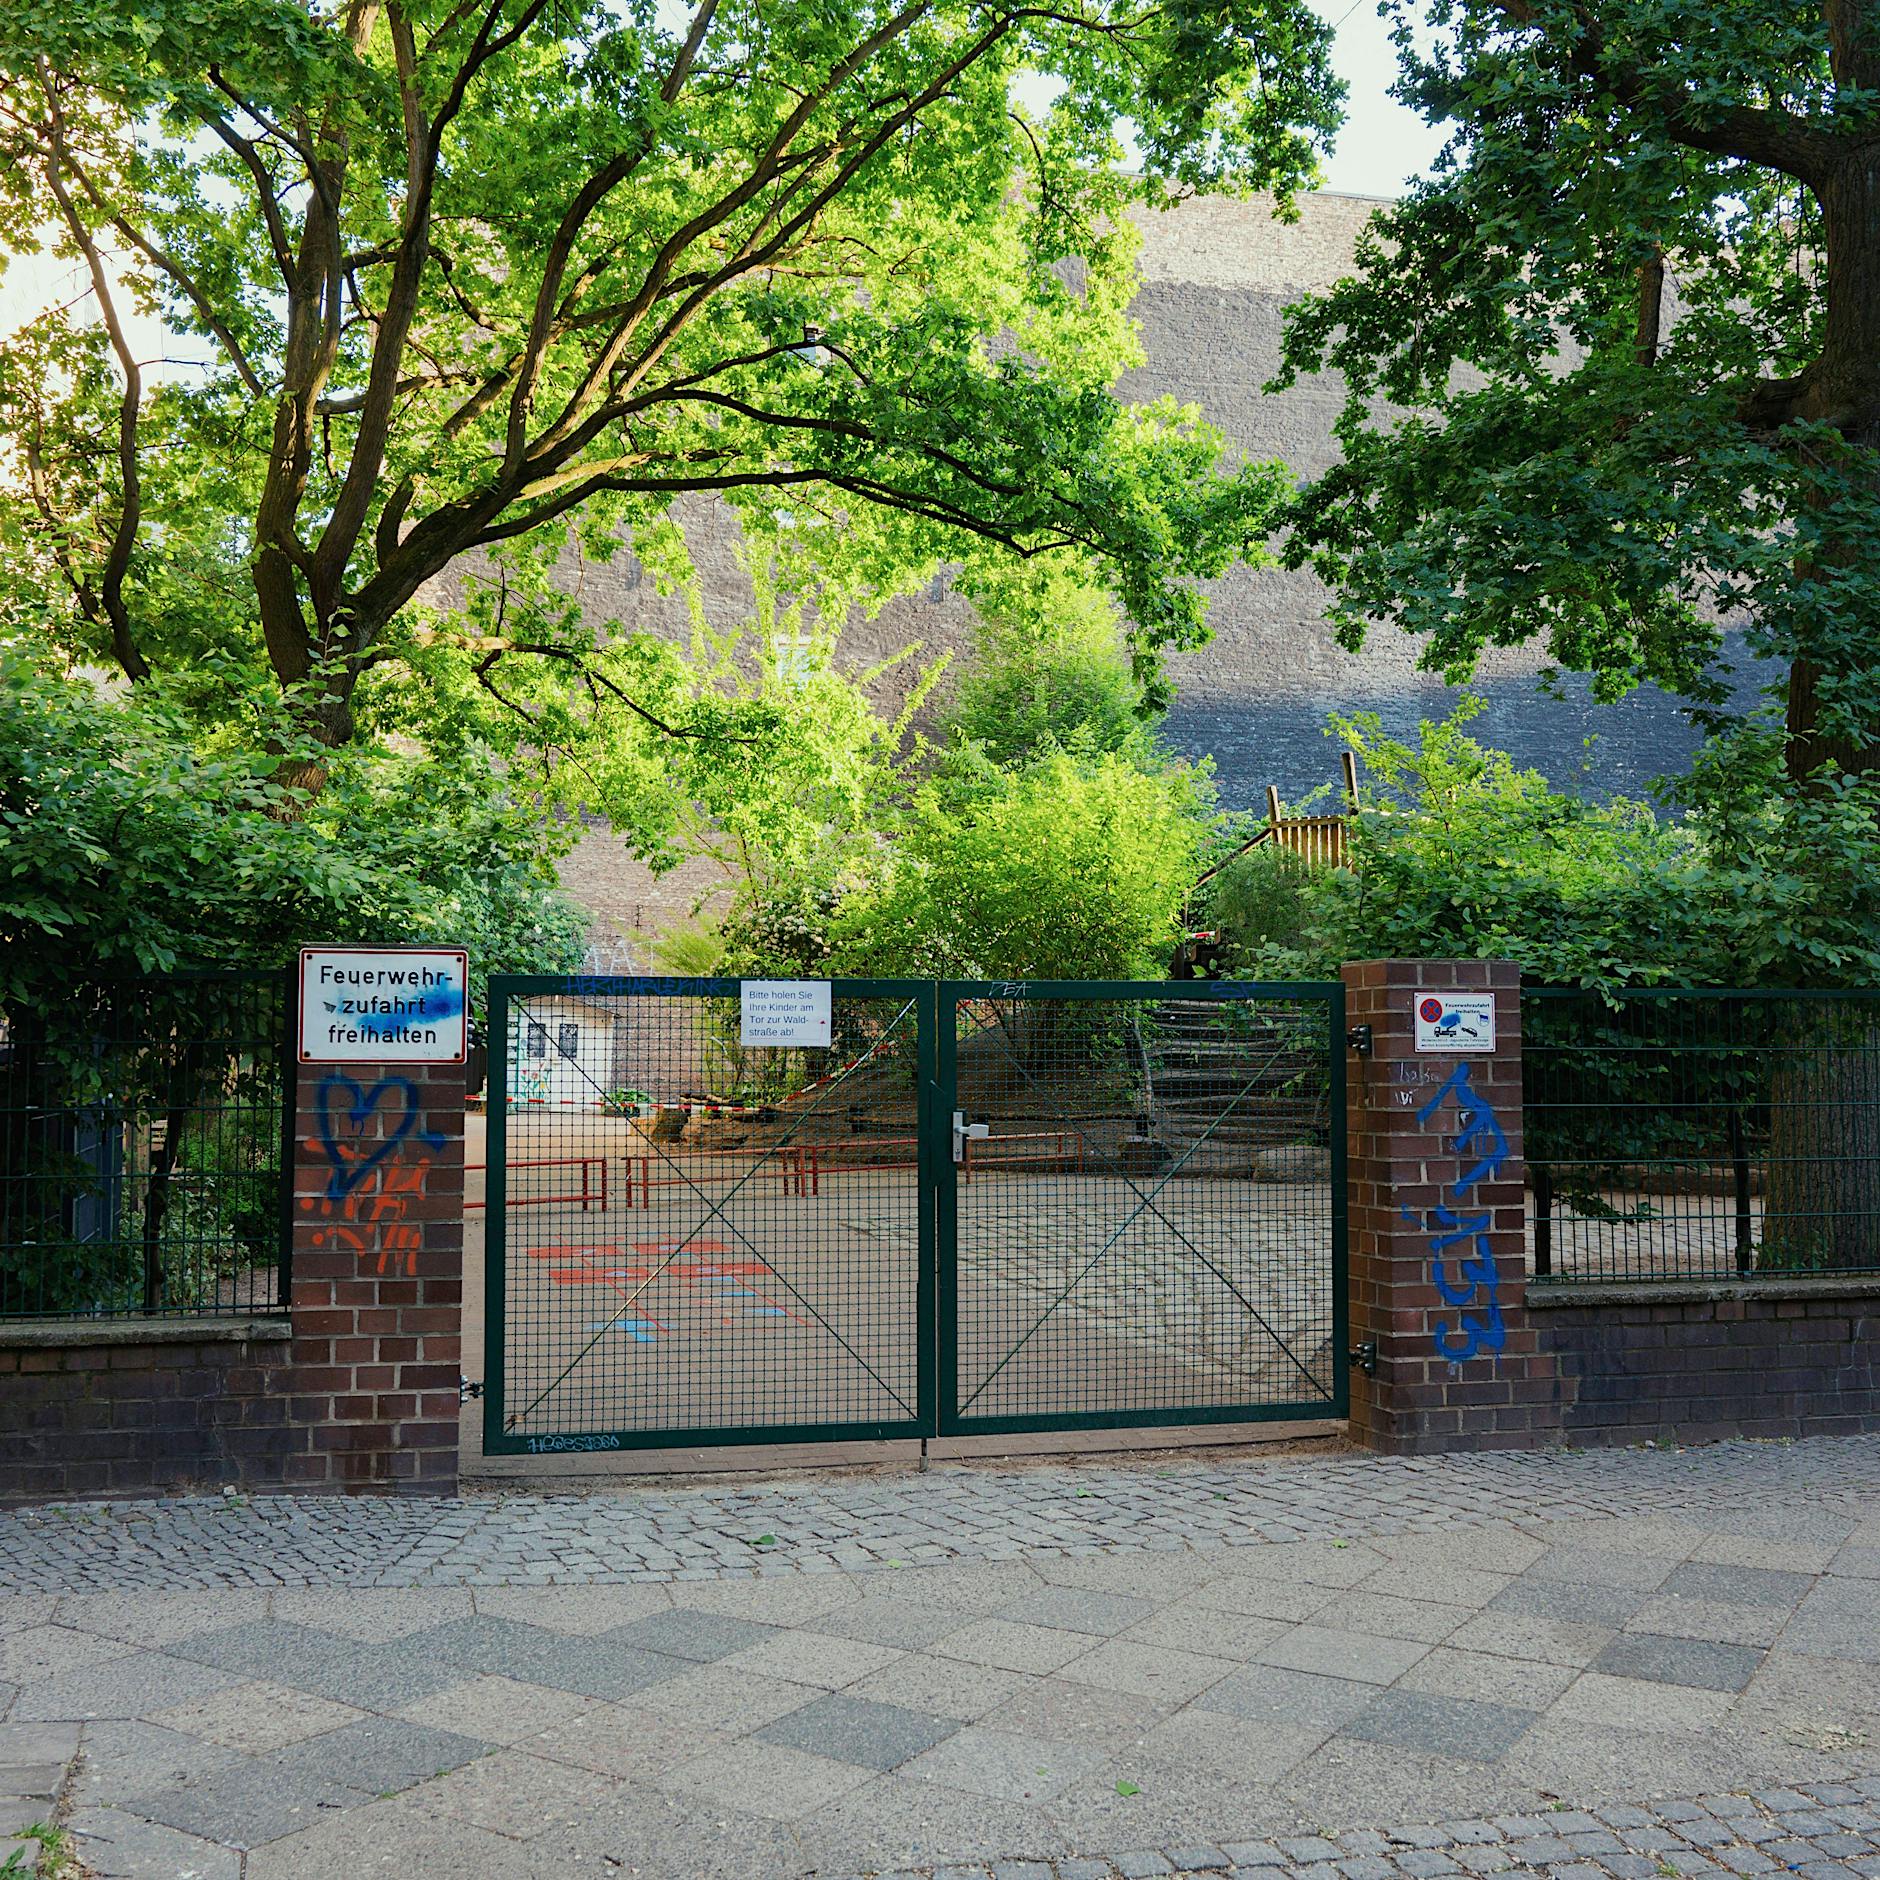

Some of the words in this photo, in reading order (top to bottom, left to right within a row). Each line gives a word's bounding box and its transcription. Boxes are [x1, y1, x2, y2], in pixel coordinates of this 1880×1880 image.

[320, 965, 453, 986] Feuerwehr-
[749, 991, 769, 999] Bitte
[771, 991, 796, 999] holen
[798, 991, 813, 999] Sie
[342, 996, 426, 1014] zufahrt
[749, 1003, 767, 1012] Ihre
[769, 1003, 797, 1012] Kinder
[750, 1015, 765, 1024] Tor
[783, 1015, 809, 1024] Wald-
[328, 1025, 437, 1044] freihalten
[749, 1028, 778, 1037] straße
[780, 1028, 794, 1037] ab!
